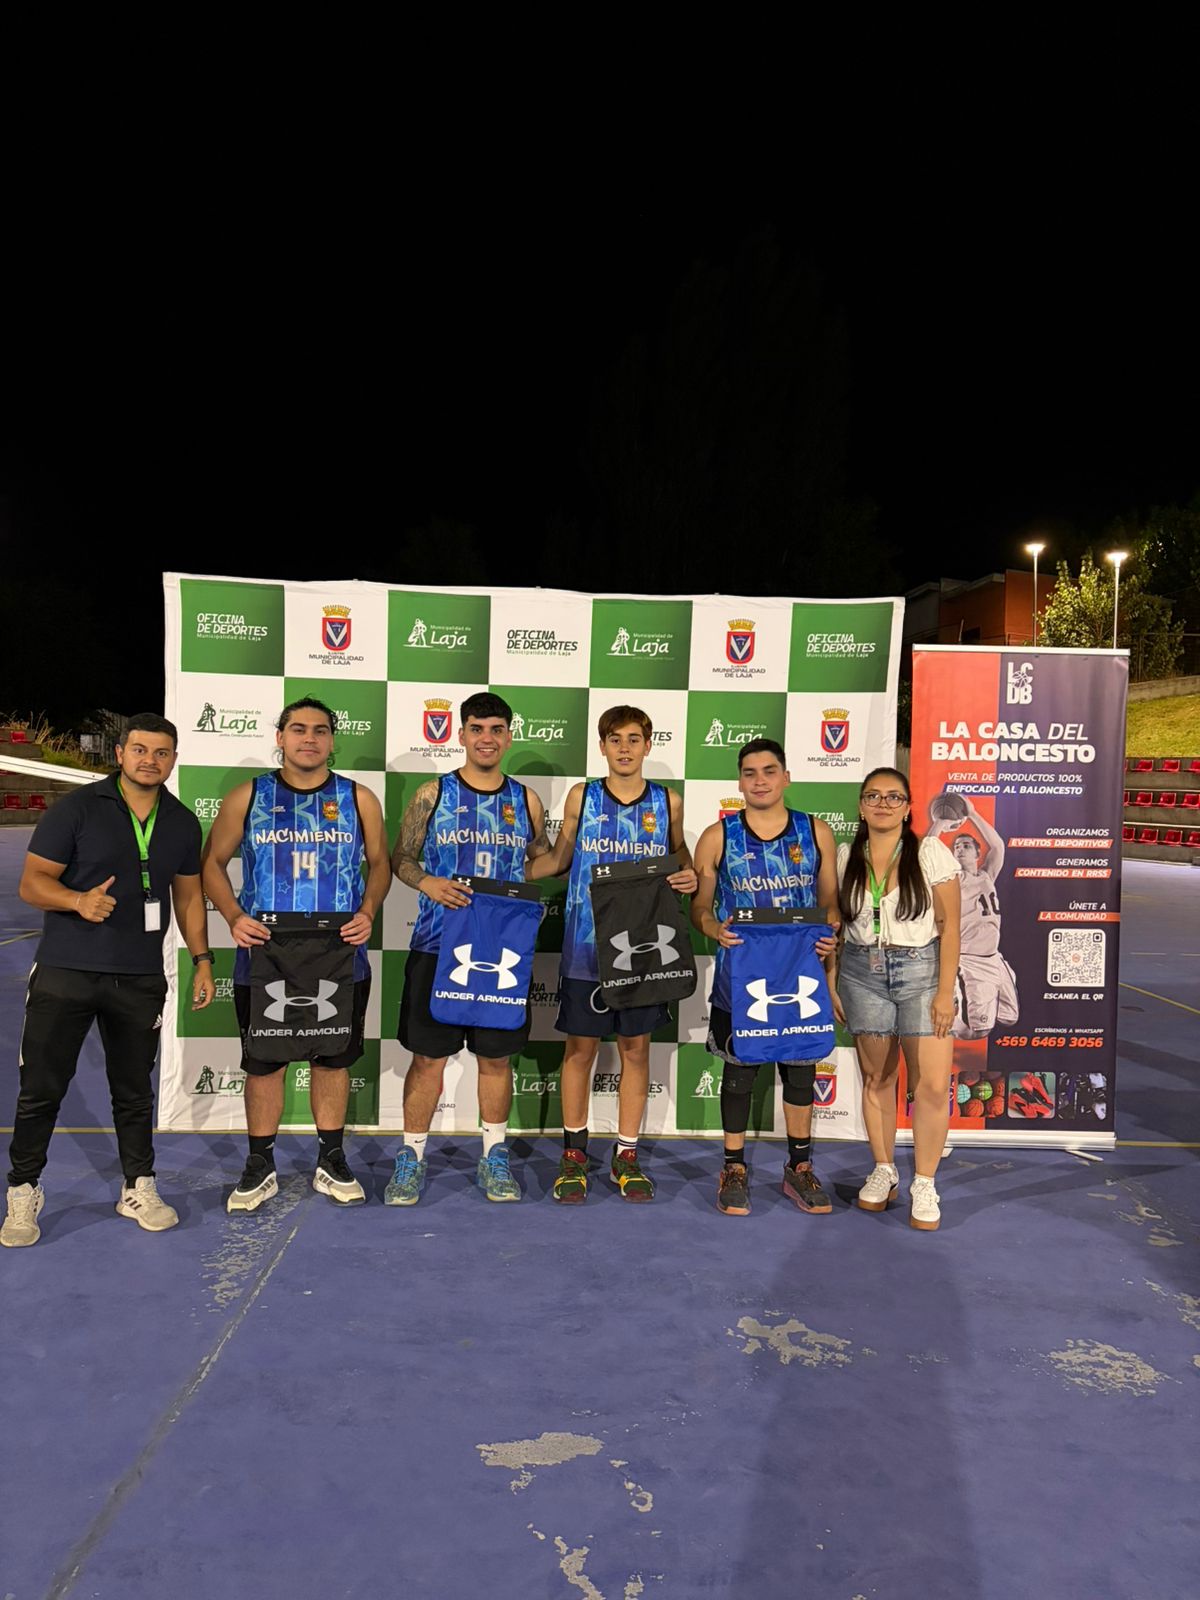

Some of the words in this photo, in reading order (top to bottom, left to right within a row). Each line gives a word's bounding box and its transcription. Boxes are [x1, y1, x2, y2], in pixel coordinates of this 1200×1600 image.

[197, 612, 244, 624] OFICINA
[197, 623, 212, 633] DE
[213, 624, 268, 636] DEPORTES
[507, 629, 555, 640] OFICINA
[430, 630, 468, 649] Laja
[808, 634, 854, 643] OFICINA
[507, 640, 522, 649] DE
[523, 640, 578, 651] DEPORTES
[632, 638, 670, 656] Laja
[806, 643, 821, 652] DE
[822, 642, 876, 652] DEPORTES
[220, 715, 258, 734] Laja
[939, 721, 970, 739] LA
[978, 722, 1040, 740] CASA
[1047, 723, 1088, 740] DEL
[528, 724, 564, 742] Laja
[931, 742, 1096, 764] BALONCESTO
[947, 772, 978, 782] VENTA
[981, 772, 994, 782] DE
[997, 774, 1055, 782] PRODUCTOS
[1058, 774, 1082, 782] 100%
[946, 784, 1000, 794] ENFOCADO
[1003, 786, 1016, 794] AL
[1019, 786, 1083, 795] BALONCESTO
[195, 798, 223, 808] OFIC
[196, 808, 210, 818] DE
[255, 827, 353, 844] NACIMIENTO
[436, 828, 527, 848] NACIMIENTO
[1046, 828, 1110, 836] ORGANIZAMOS
[581, 837, 666, 856] NACIMIENTO
[1011, 839, 1052, 847] EVENTOS
[1054, 839, 1110, 848] DEPORTIVOS
[291, 850, 317, 880] 14
[476, 850, 492, 878] 9
[1056, 858, 1109, 866] GENERAMOS
[1017, 868, 1069, 877] CONTENIDO
[1071, 869, 1084, 877] EN
[1086, 869, 1108, 878] RRSS
[731, 874, 814, 893] NACIMIENTO
[1069, 900, 1098, 910] ÚNETE
[1054, 912, 1108, 920] COMUNIDAD
[602, 976, 642, 989] UNDER
[644, 970, 694, 982] ARMOUR
[435, 990, 474, 1001] UNDER
[476, 994, 527, 1006] ARMOUR
[251, 1029, 293, 1038] UNDER
[296, 1026, 351, 1036] ARMOUR
[736, 1029, 778, 1038] UNDER
[782, 1024, 834, 1036] ARMOUR
[995, 1036, 1028, 1046] +569
[1031, 1036, 1066, 1047] 6469
[1068, 1037, 1104, 1047] 3056
[296, 1078, 310, 1087] DE
[594, 1074, 621, 1083] OFIC
[218, 1076, 245, 1094] Laj
[521, 1078, 557, 1096] Laja
[594, 1084, 608, 1092] DE
